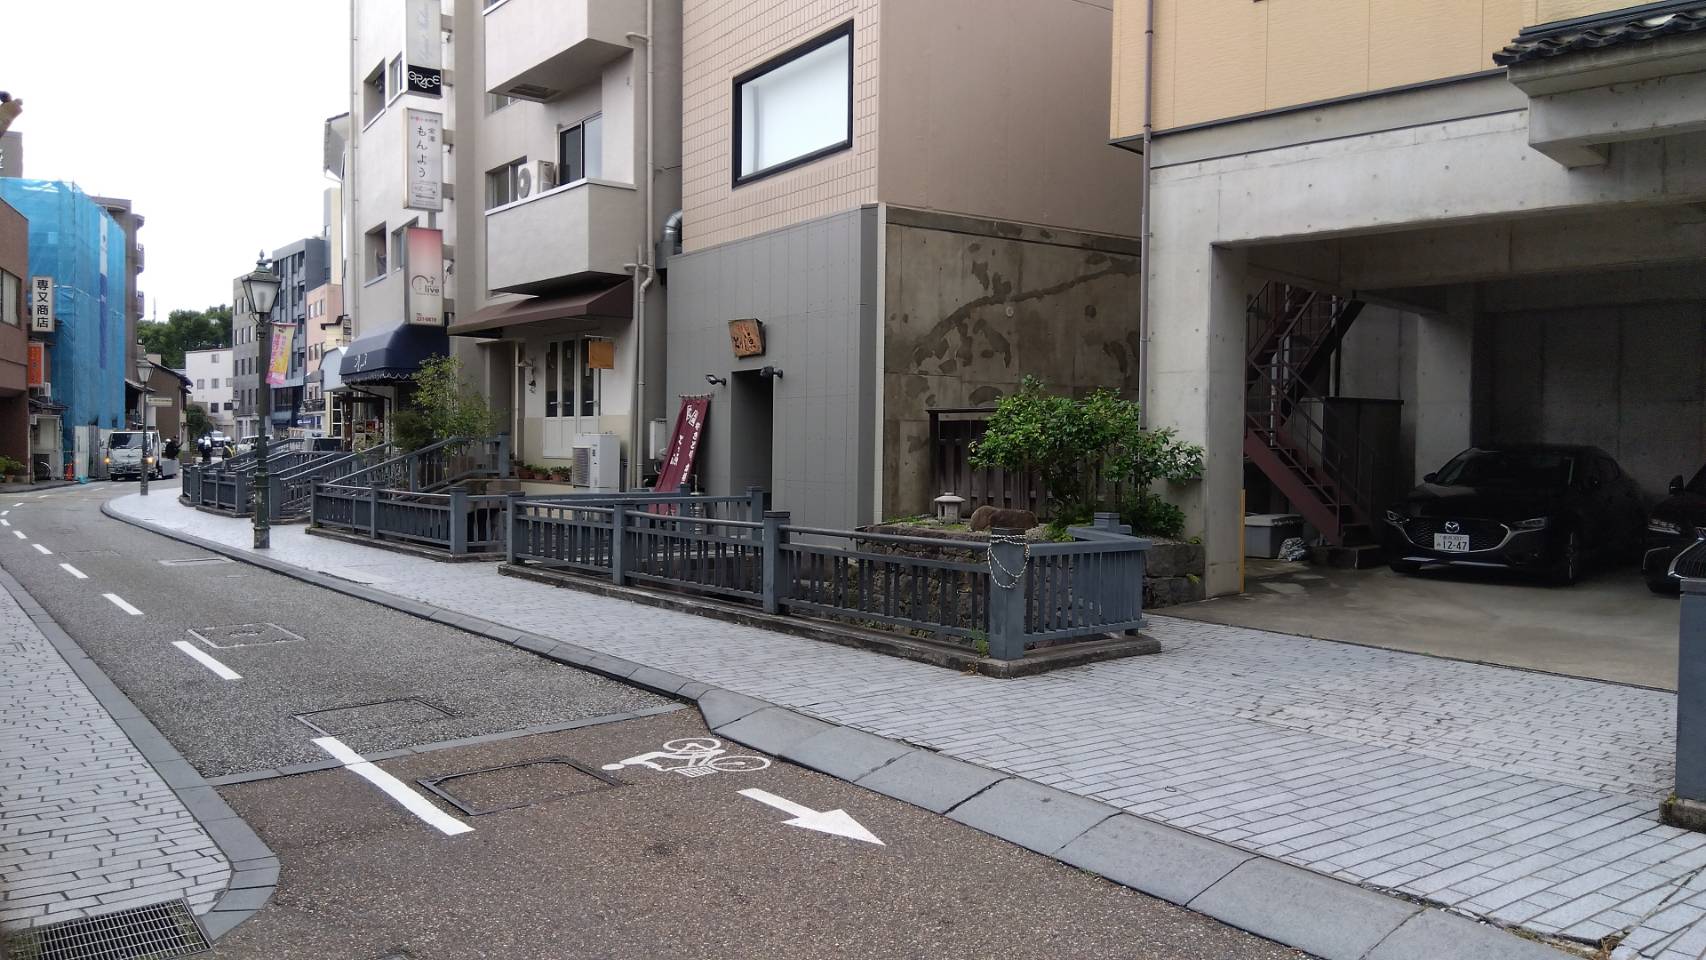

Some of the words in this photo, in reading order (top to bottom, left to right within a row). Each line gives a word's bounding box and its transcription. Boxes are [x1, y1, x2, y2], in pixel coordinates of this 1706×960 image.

[408, 70, 440, 89] GRACE
[416, 125, 428, 178] もんよう
[1443, 540, 1467, 550] 12-47
